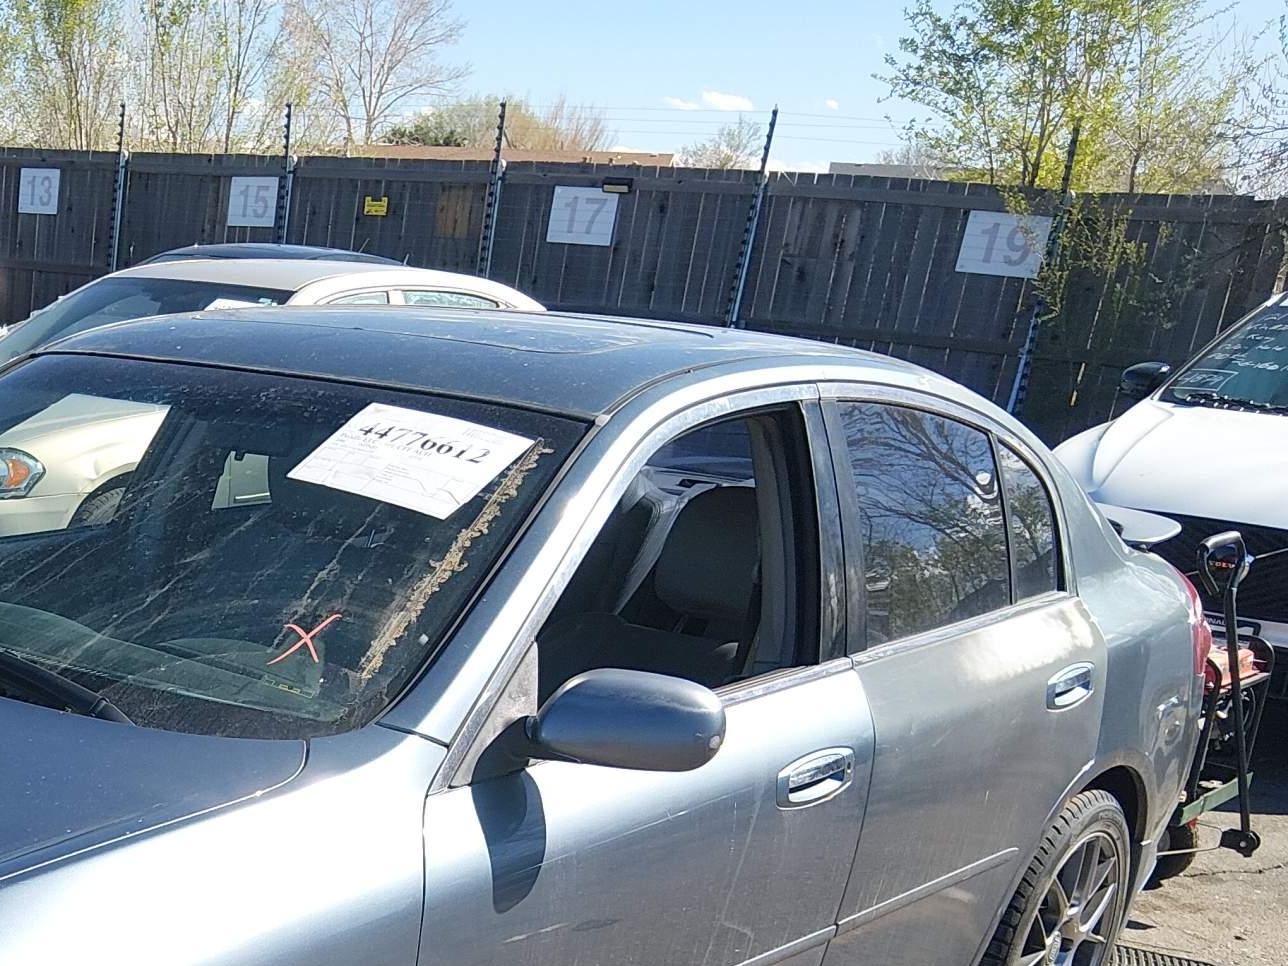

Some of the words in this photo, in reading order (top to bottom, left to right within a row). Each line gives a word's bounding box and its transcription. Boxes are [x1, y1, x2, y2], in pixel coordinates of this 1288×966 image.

[27, 176, 52, 207] 13
[240, 184, 270, 219] 15
[564, 195, 609, 235] 17
[980, 222, 1032, 266] 19
[358, 422, 491, 465] 44776612
